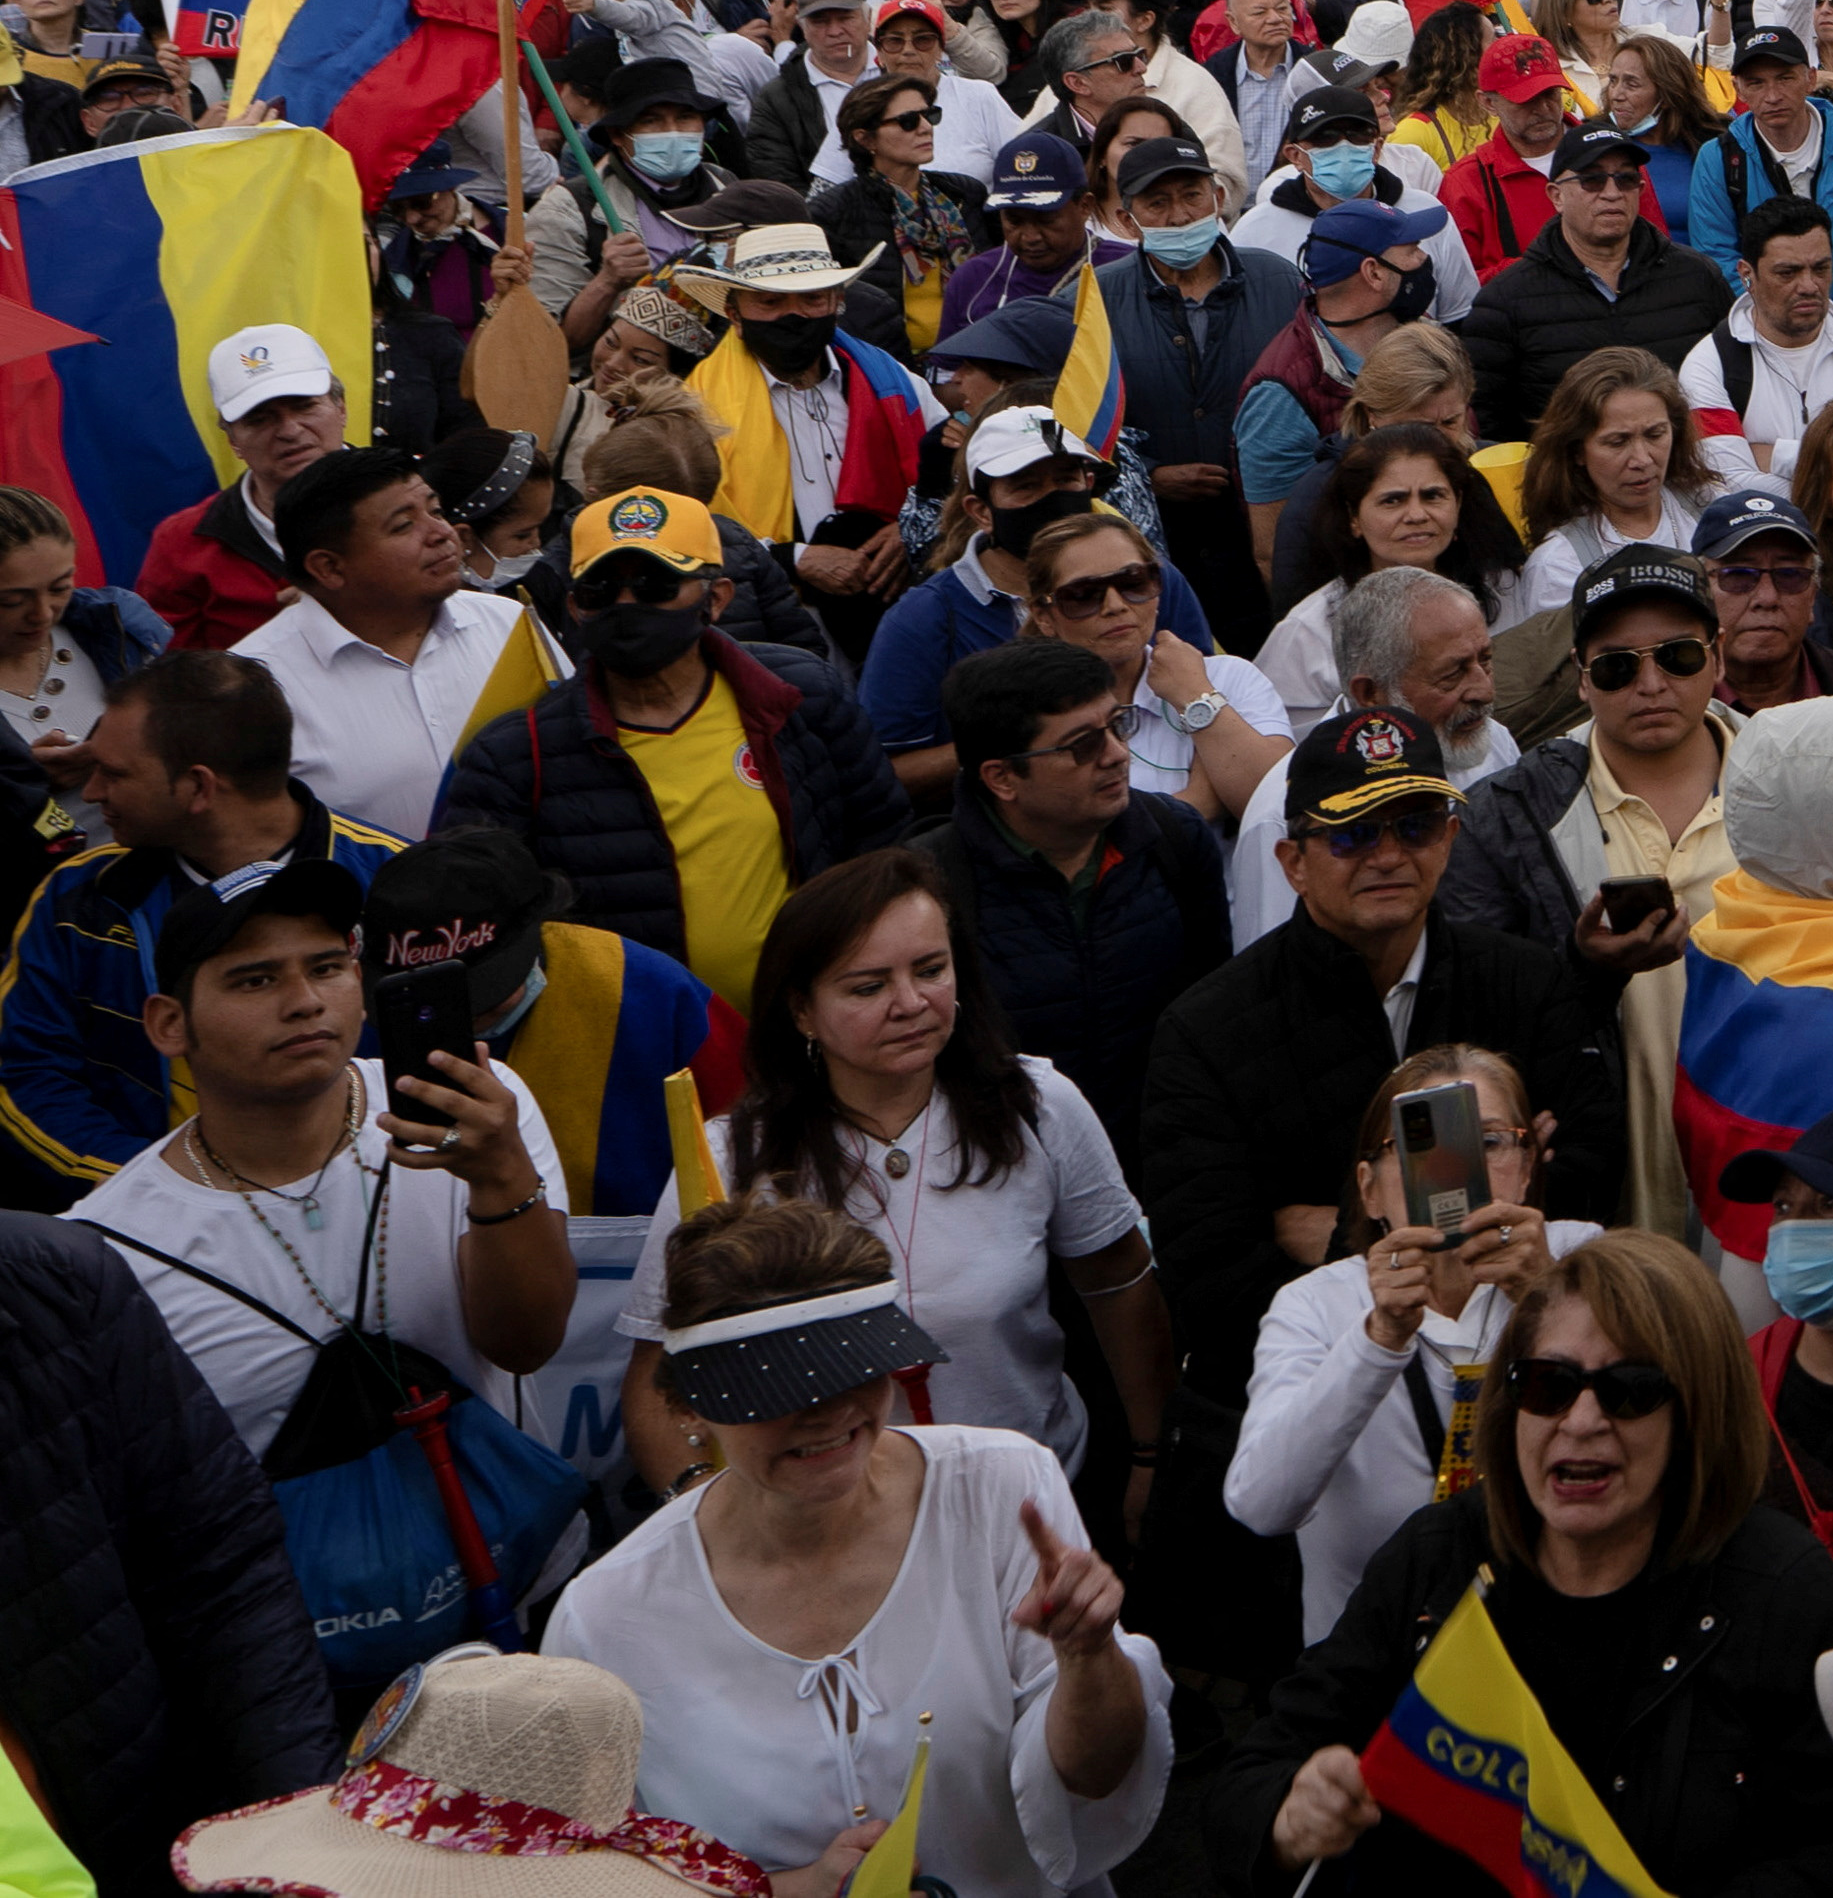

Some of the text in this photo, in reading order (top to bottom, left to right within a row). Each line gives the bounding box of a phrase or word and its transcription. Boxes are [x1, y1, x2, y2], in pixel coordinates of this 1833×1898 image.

[1630, 563, 1694, 587] BOSS
[1364, 760, 1411, 775] COLOMBIA
[316, 1605, 403, 1639] OKIA
